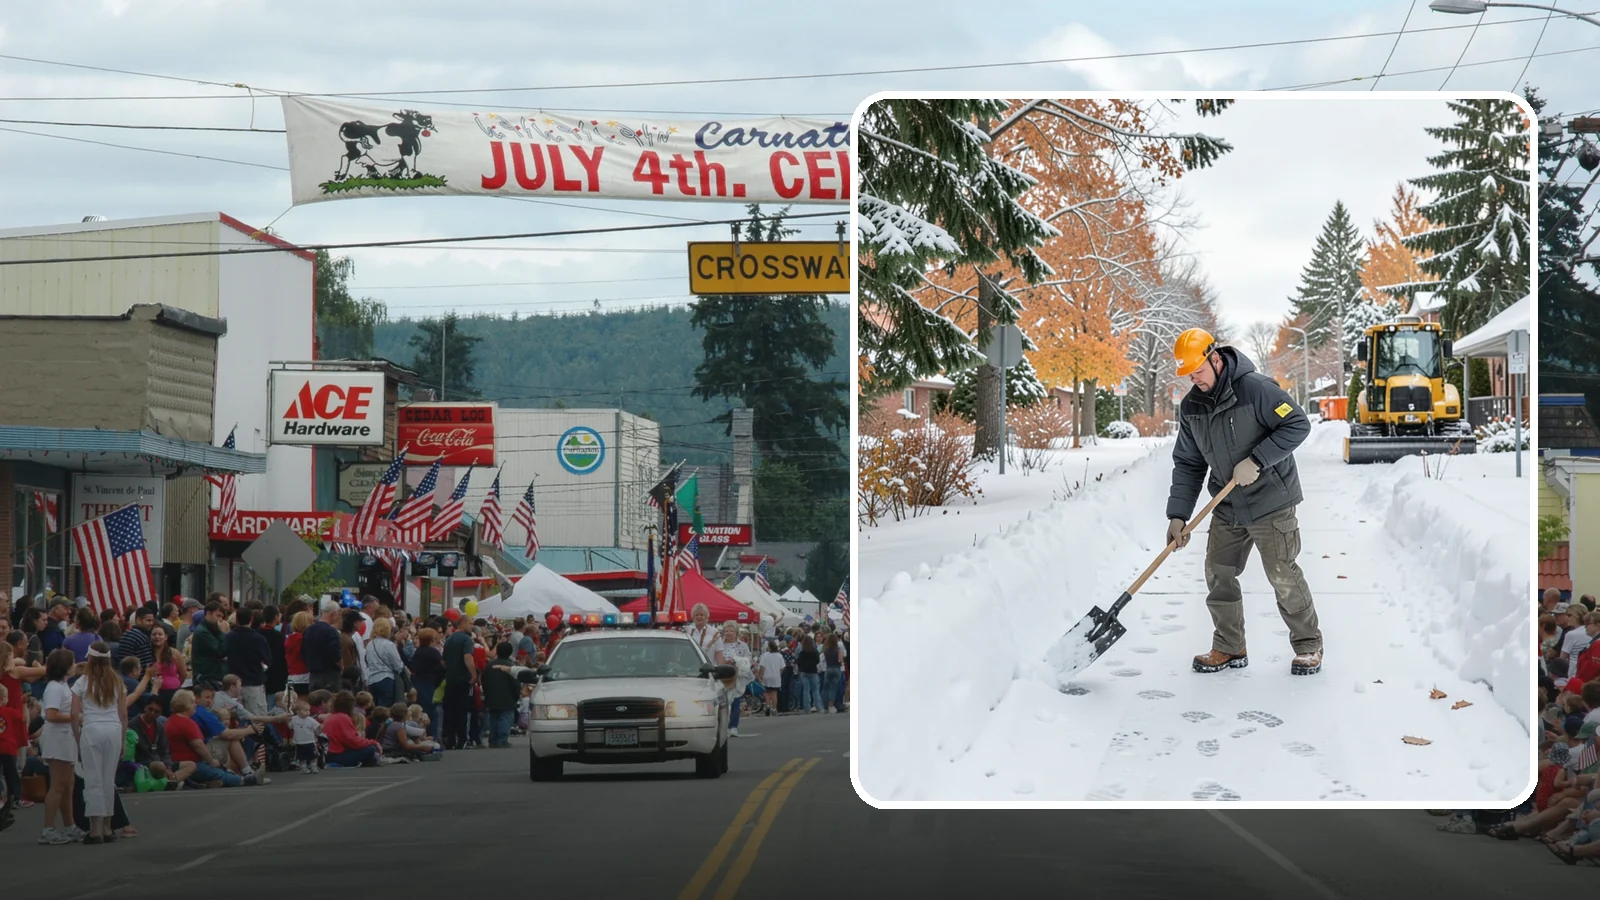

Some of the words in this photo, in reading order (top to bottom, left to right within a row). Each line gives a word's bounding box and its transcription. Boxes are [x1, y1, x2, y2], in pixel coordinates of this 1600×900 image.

[481, 141, 605, 192] JULY
[632, 150, 746, 198] 4th.
[697, 255, 850, 281] CROSSWA
[283, 380, 374, 420] ACE
[405, 409, 453, 422] CEDAR
[461, 409, 485, 421] LOG
[283, 421, 371, 436] Hardware
[416, 428, 476, 447] Coca-Cola
[83, 485, 94, 494] St.
[95, 485, 125, 495] Vincent
[126, 486, 136, 495] de
[138, 486, 155, 495] Paul
[688, 526, 741, 535] CRNATION
[699, 535, 730, 543] GLASS
